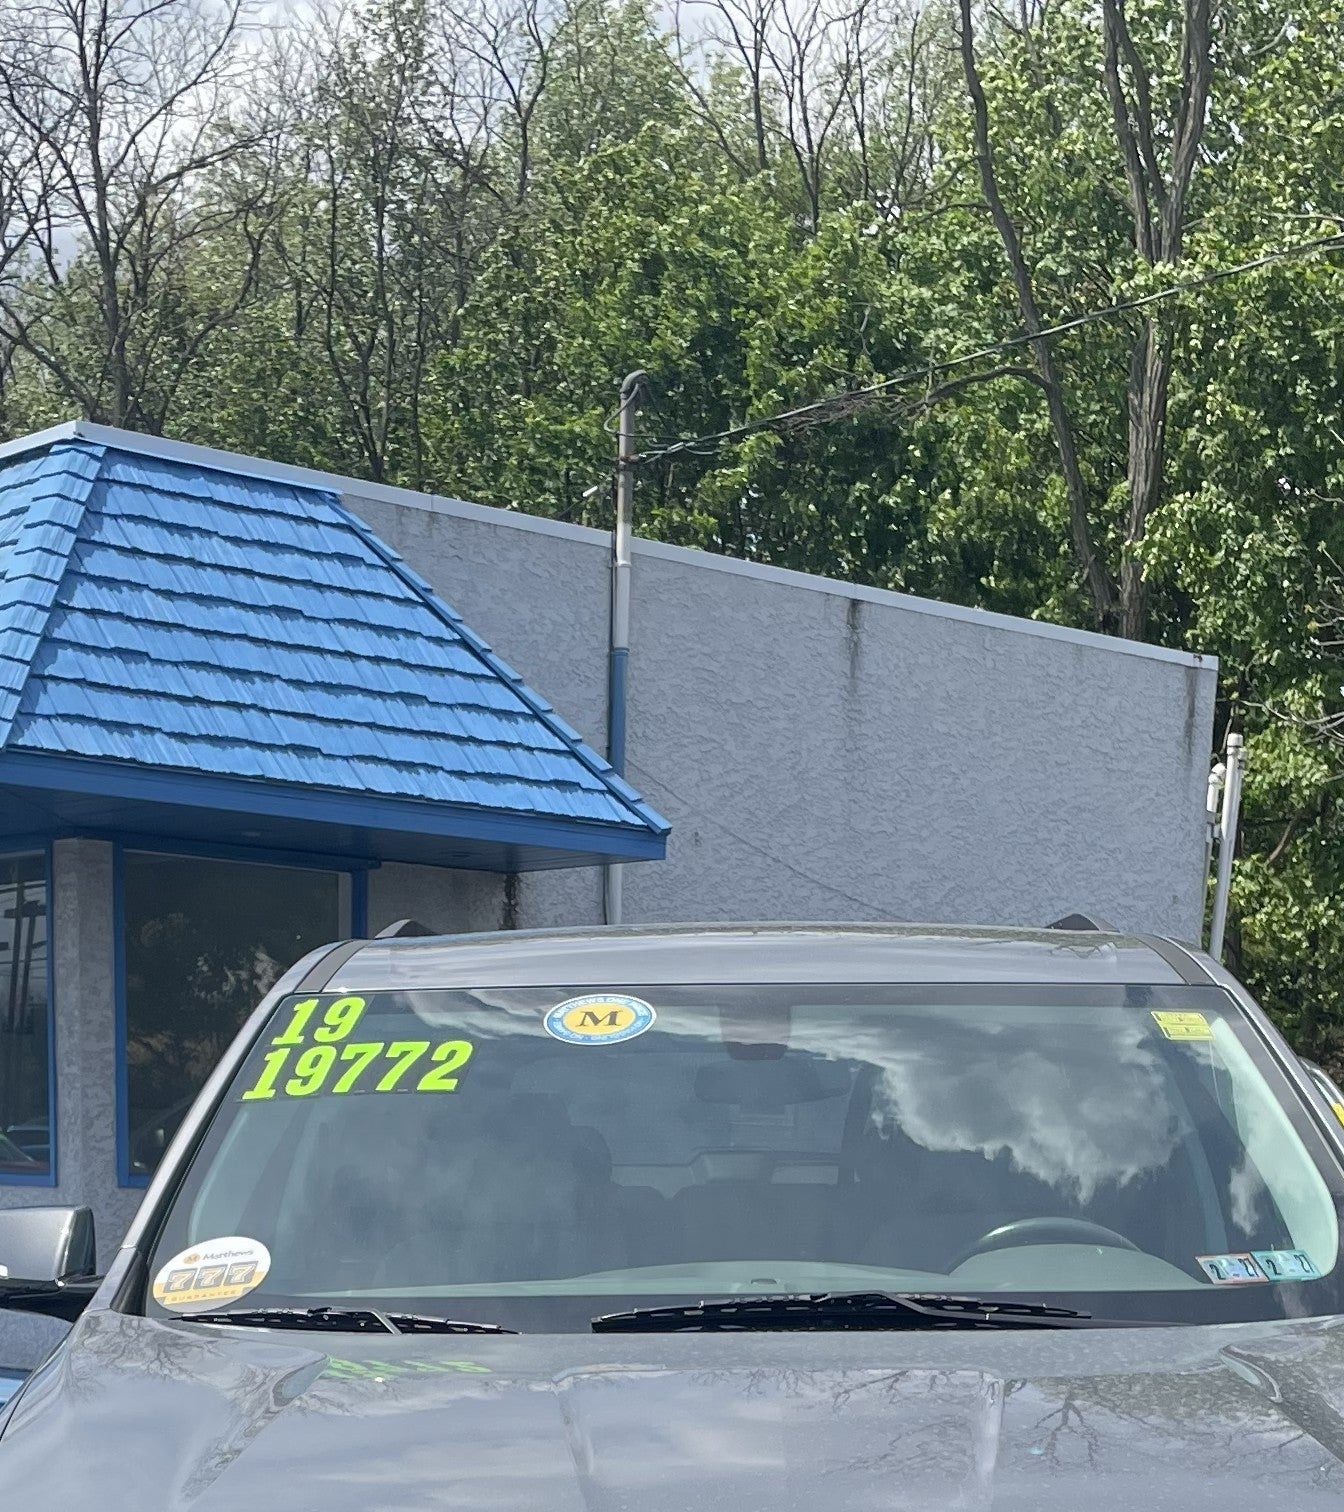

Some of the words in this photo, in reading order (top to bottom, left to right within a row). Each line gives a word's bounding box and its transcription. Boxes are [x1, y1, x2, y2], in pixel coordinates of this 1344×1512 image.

[271, 997, 366, 1045] 19
[575, 1010, 623, 1027] M
[241, 1040, 473, 1100] 19772
[203, 1250, 254, 1260] Matthews
